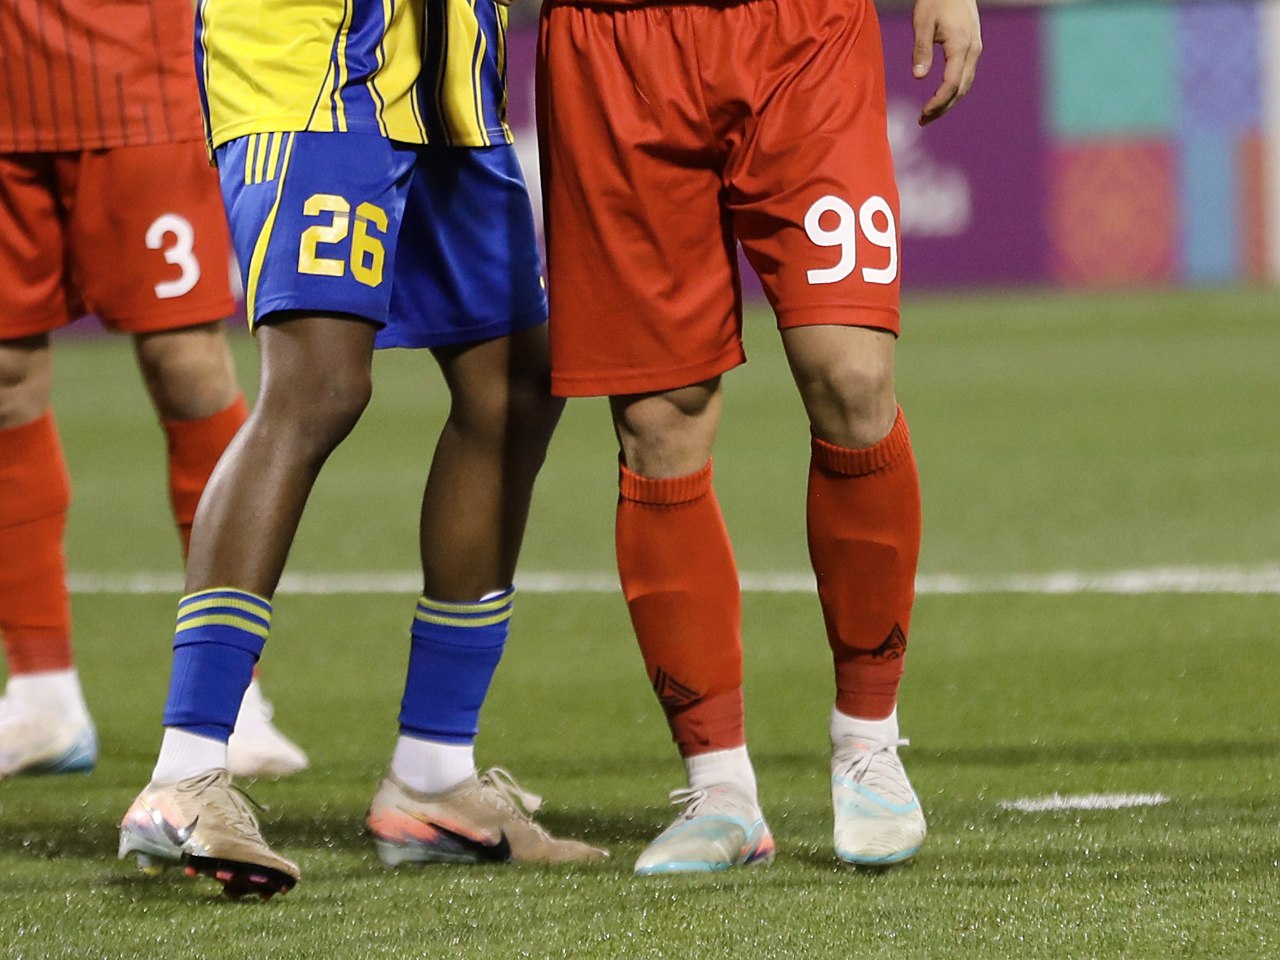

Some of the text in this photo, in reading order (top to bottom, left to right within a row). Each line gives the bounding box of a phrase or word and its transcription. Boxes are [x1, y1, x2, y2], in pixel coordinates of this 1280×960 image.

[145, 213, 201, 299] 3
[297, 193, 389, 288] 26
[804, 194, 898, 285] 99
